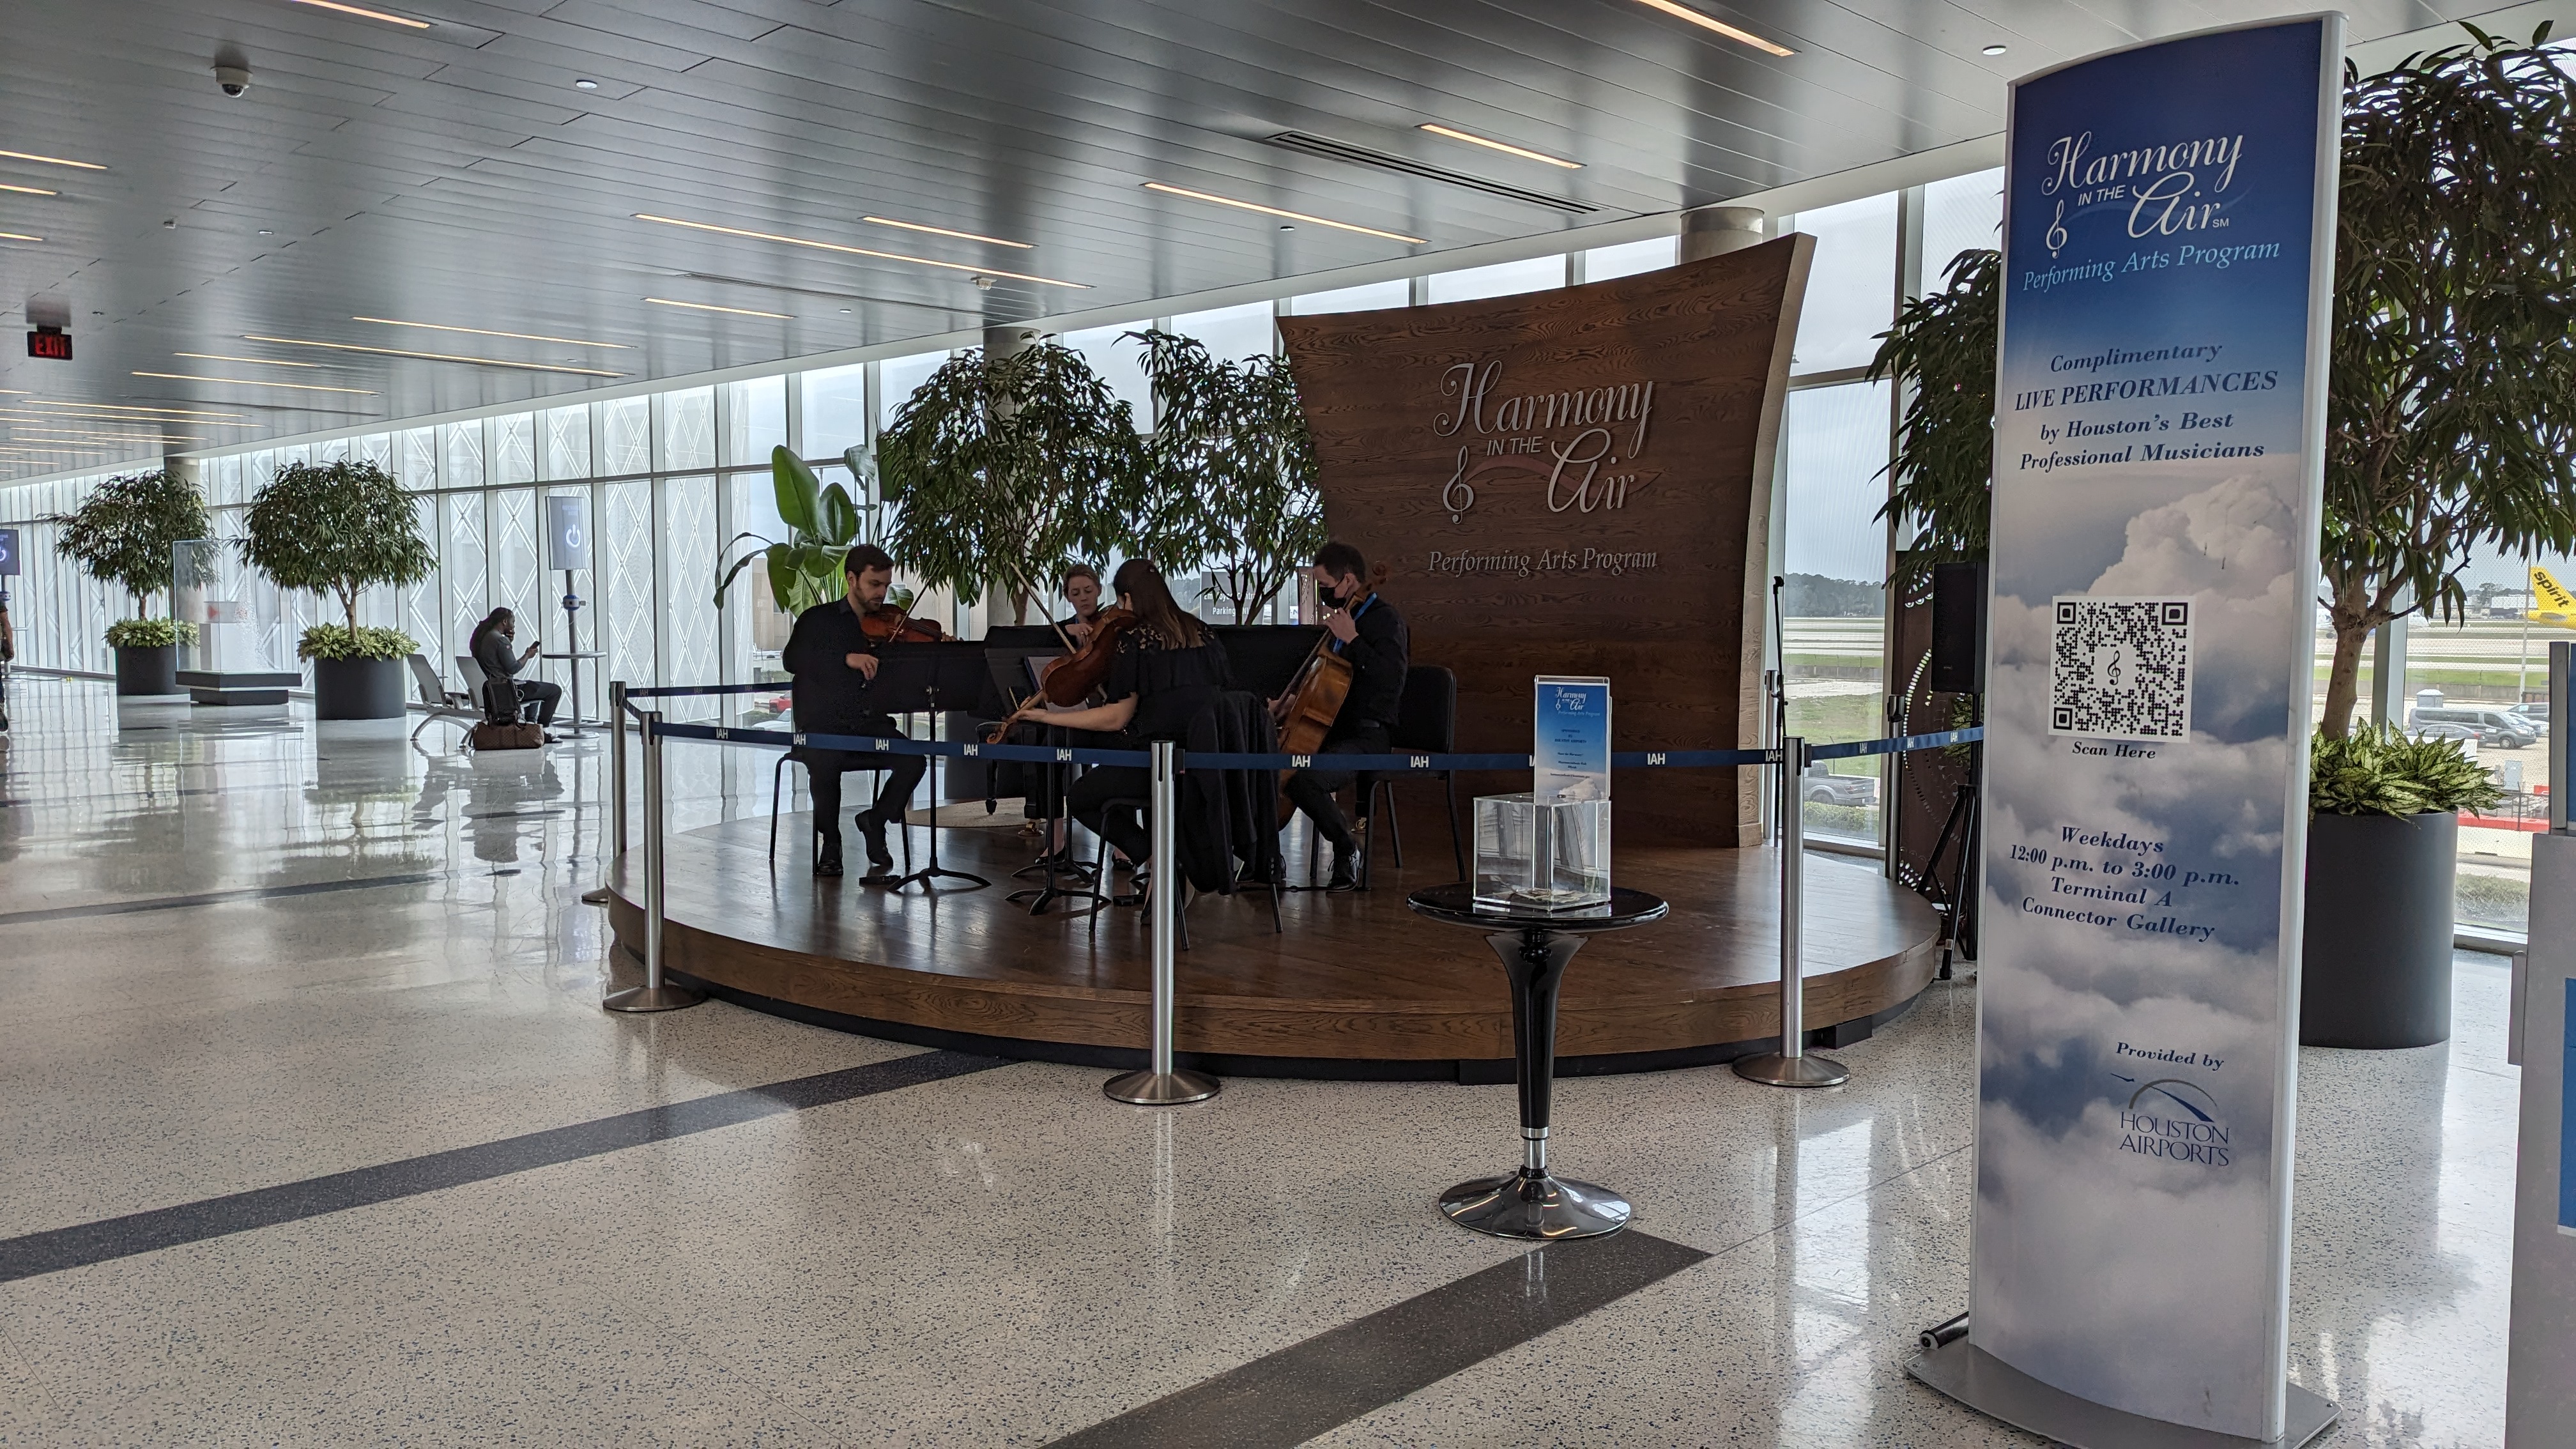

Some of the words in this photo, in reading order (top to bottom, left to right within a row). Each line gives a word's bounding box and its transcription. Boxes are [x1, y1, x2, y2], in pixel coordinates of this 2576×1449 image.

[2041, 131, 2243, 195] Harmony
[2078, 190, 2092, 206] IN
[2096, 185, 2126, 203] THE
[2128, 171, 2221, 238] Air
[2212, 217, 2230, 228] SM
[2023, 259, 2115, 293] Performing
[2121, 250, 2170, 273] Arts
[2178, 242, 2280, 269] Program
[2050, 343, 2222, 373] Complimentary
[2015, 389, 2055, 411] LIVE
[2060, 371, 2278, 406] PERFORMANCES
[1433, 360, 1653, 459] Harmony
[2041, 424, 2060, 444] by
[2066, 413, 2170, 438] Houston's
[2181, 411, 2234, 430] Best
[1486, 439, 1505, 456] IN
[1509, 436, 1544, 454] THE
[1547, 428, 1635, 513] Air
[2020, 446, 2133, 473] Professional
[2140, 442, 2264, 462] Musicians
[1428, 549, 1531, 578] Performing
[1537, 549, 1576, 571] Arts
[1581, 548, 1658, 576] Program
[2534, 571, 2570, 608] spirit
[1213, 606, 1236, 617] Parking
[716, 728, 728, 739] IAH
[793, 733, 806, 746] IAH
[875, 739, 889, 751] IAH
[963, 744, 978, 756] IAH
[1056, 748, 1072, 762] IAH
[1291, 755, 1311, 768] IAH
[1410, 755, 1429, 768] IAH
[1646, 753, 1666, 765] IAH
[1765, 749, 1783, 762] IAH
[2071, 741, 2108, 756] Scan
[2114, 744, 2156, 760] Here
[2061, 826, 2163, 856] Weekdays
[2009, 844, 2047, 864] 12:00
[2050, 855, 2094, 873] p.m.
[2103, 861, 2123, 877] to
[2131, 861, 2176, 881] 3:00
[2181, 871, 2239, 887] p.m.
[2051, 876, 2146, 905] Terminal
[2154, 891, 2172, 907] A
[2021, 896, 2117, 927] Connector
[2126, 914, 2215, 942] Gallery
[2116, 1041, 2196, 1065] Provided
[2202, 1054, 2225, 1071] by
[2120, 1111, 2229, 1145] HOUSTON
[2119, 1133, 2229, 1167] AIRPORTS
